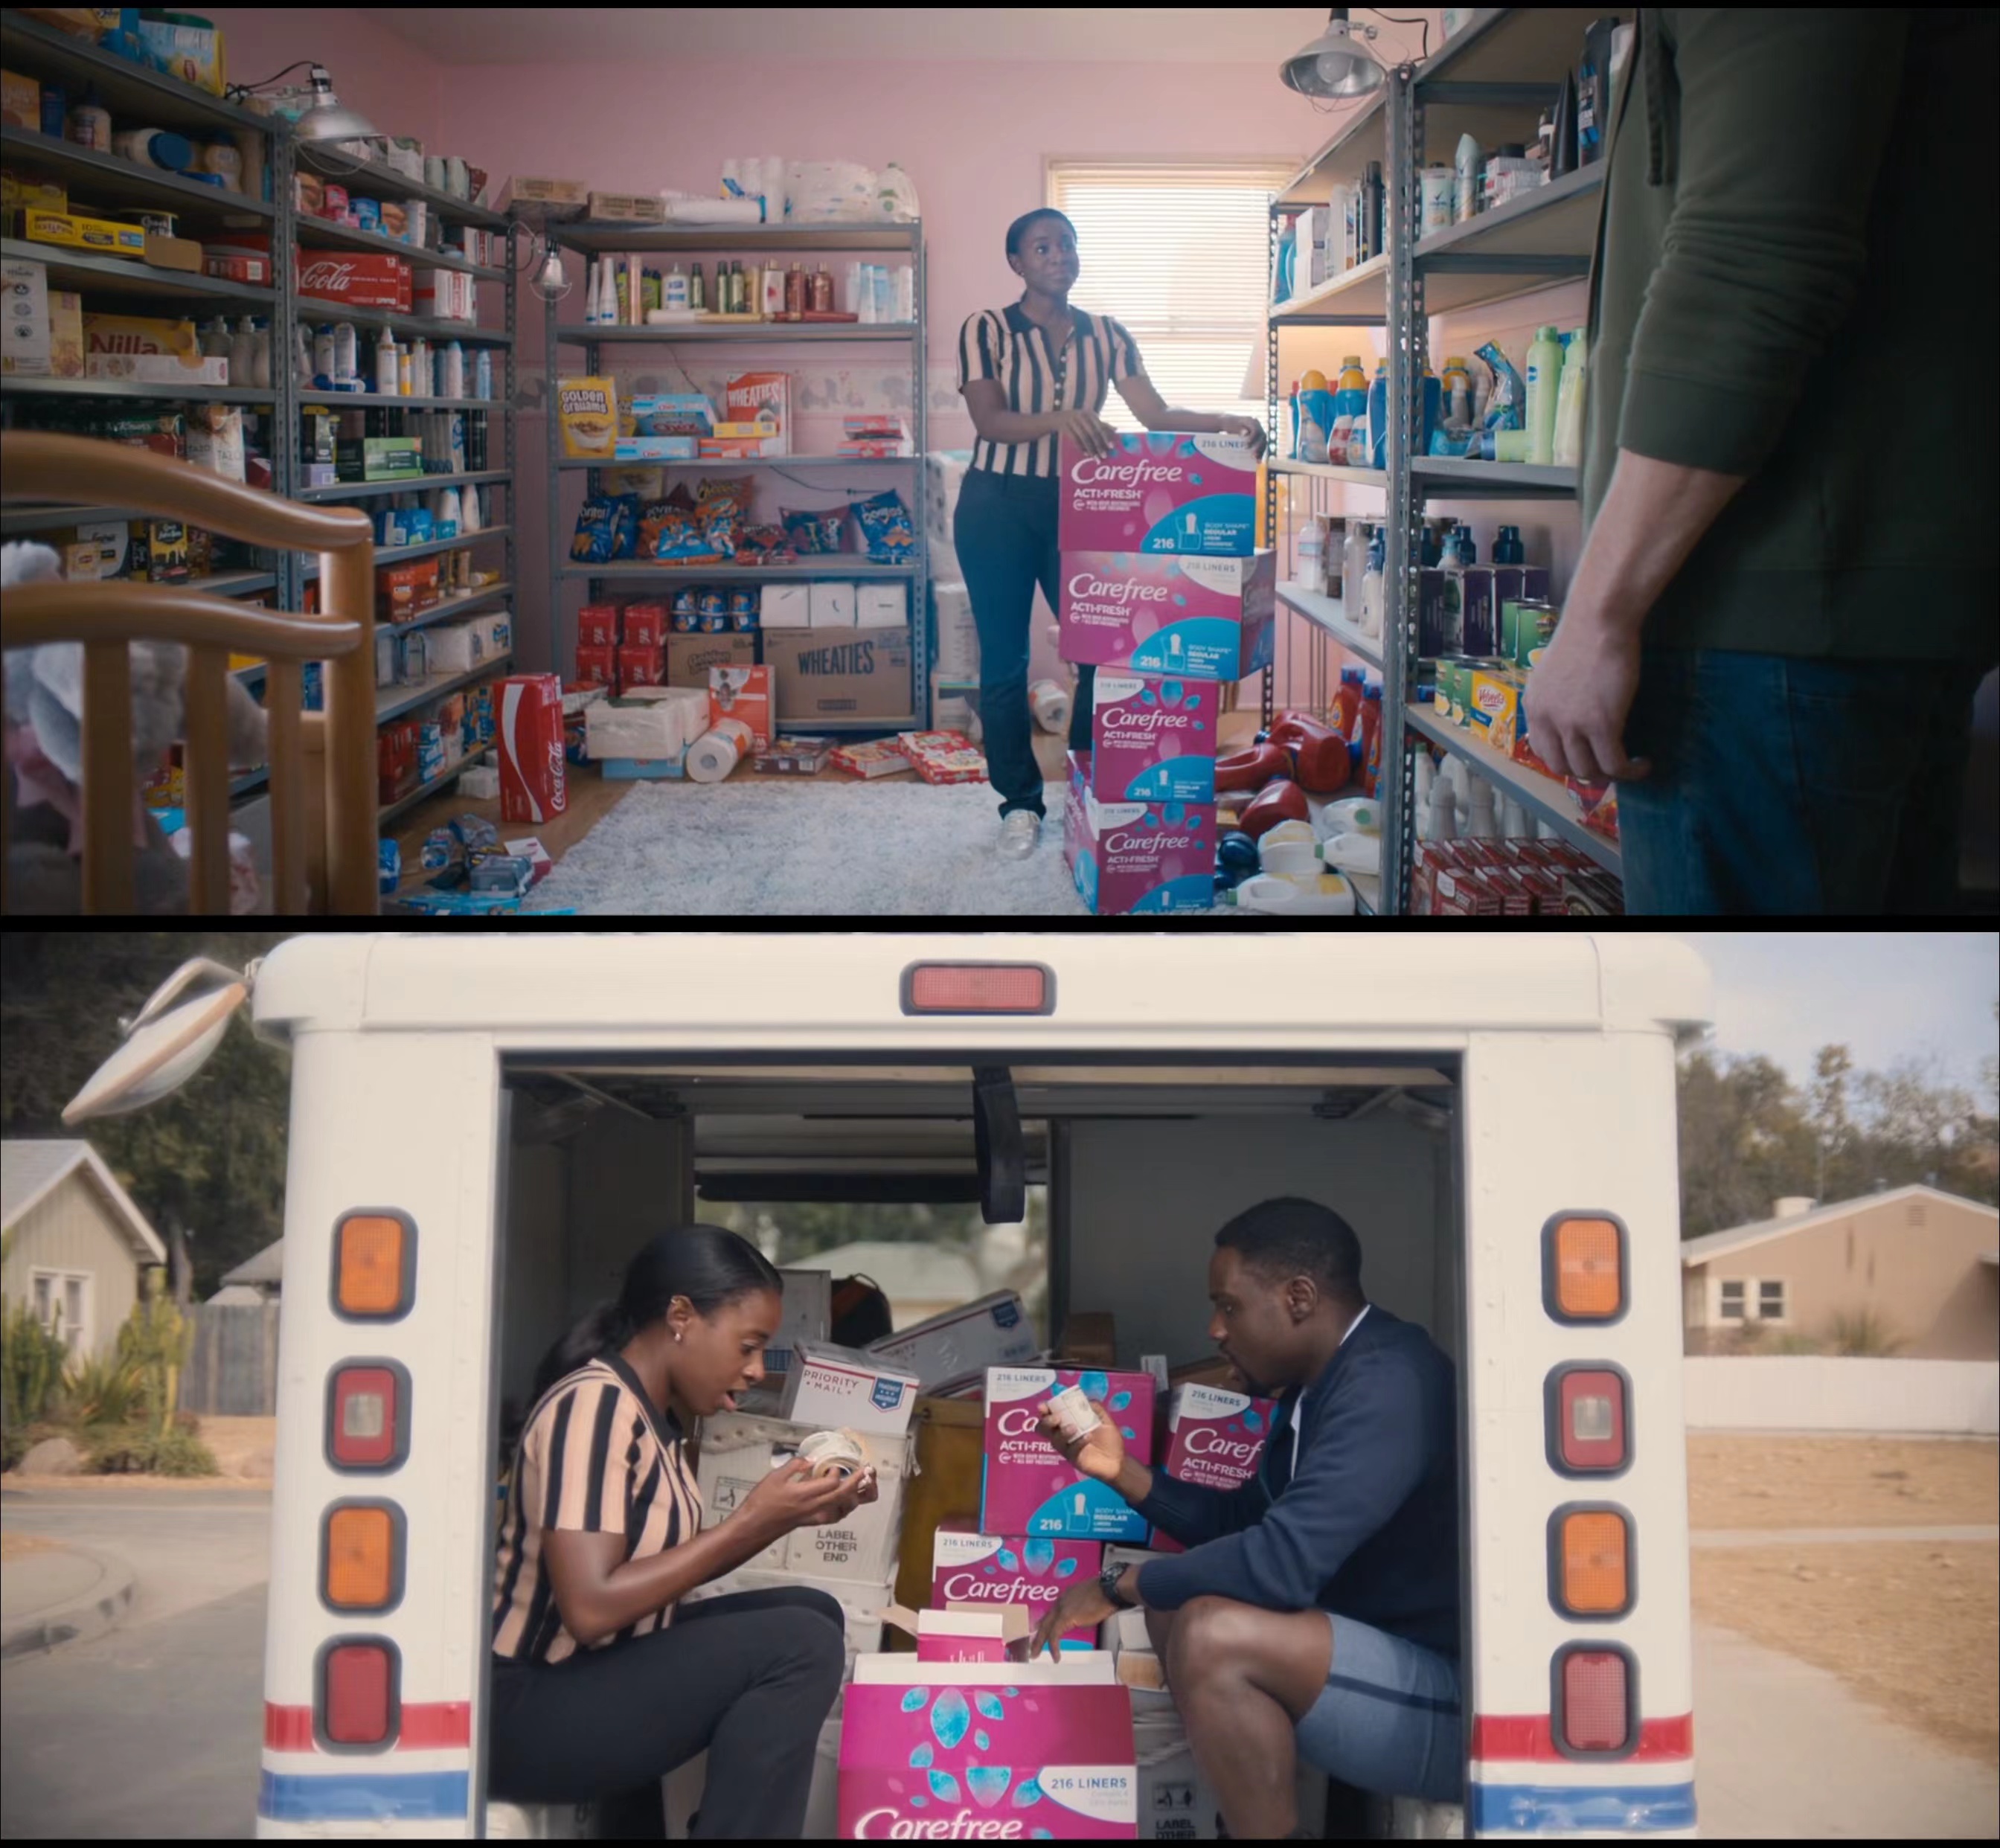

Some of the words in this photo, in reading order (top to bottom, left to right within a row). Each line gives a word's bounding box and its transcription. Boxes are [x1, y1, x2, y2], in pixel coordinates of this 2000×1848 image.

[89, 333, 158, 354] Nilla
[1071, 458, 1182, 487] Carefree
[1153, 539, 1175, 549] 216
[1203, 563, 1235, 572] LINERS
[1068, 574, 1167, 604] Carefree
[798, 641, 875, 676] WHEATIES
[1140, 655, 1161, 667] 216
[1102, 708, 1188, 731] Carefree
[548, 741, 565, 811] Coca-Cola
[1105, 832, 1190, 854] Carefree
[804, 1370, 859, 1388] PRIORITY
[1015, 1374, 1046, 1382] LINERS
[814, 1382, 843, 1394] MAIL
[1191, 1390, 1207, 1399] 216
[1208, 1393, 1241, 1407] LINERS
[999, 1440, 1057, 1451] ACTI-FRE
[1184, 1428, 1265, 1466] Caref
[1040, 1519, 1062, 1530] 216
[818, 1530, 856, 1541] LABEL
[815, 1541, 857, 1552] OTHER
[943, 1539, 958, 1547] 216
[961, 1540, 993, 1548] LINERS
[823, 1552, 848, 1562] END
[943, 1573, 1060, 1604] Carefree
[1051, 1779, 1073, 1789] 216
[1078, 1778, 1127, 1789] LINERS
[854, 1806, 1023, 1840] Carefree
[1156, 1820, 1195, 1829] LABEL
